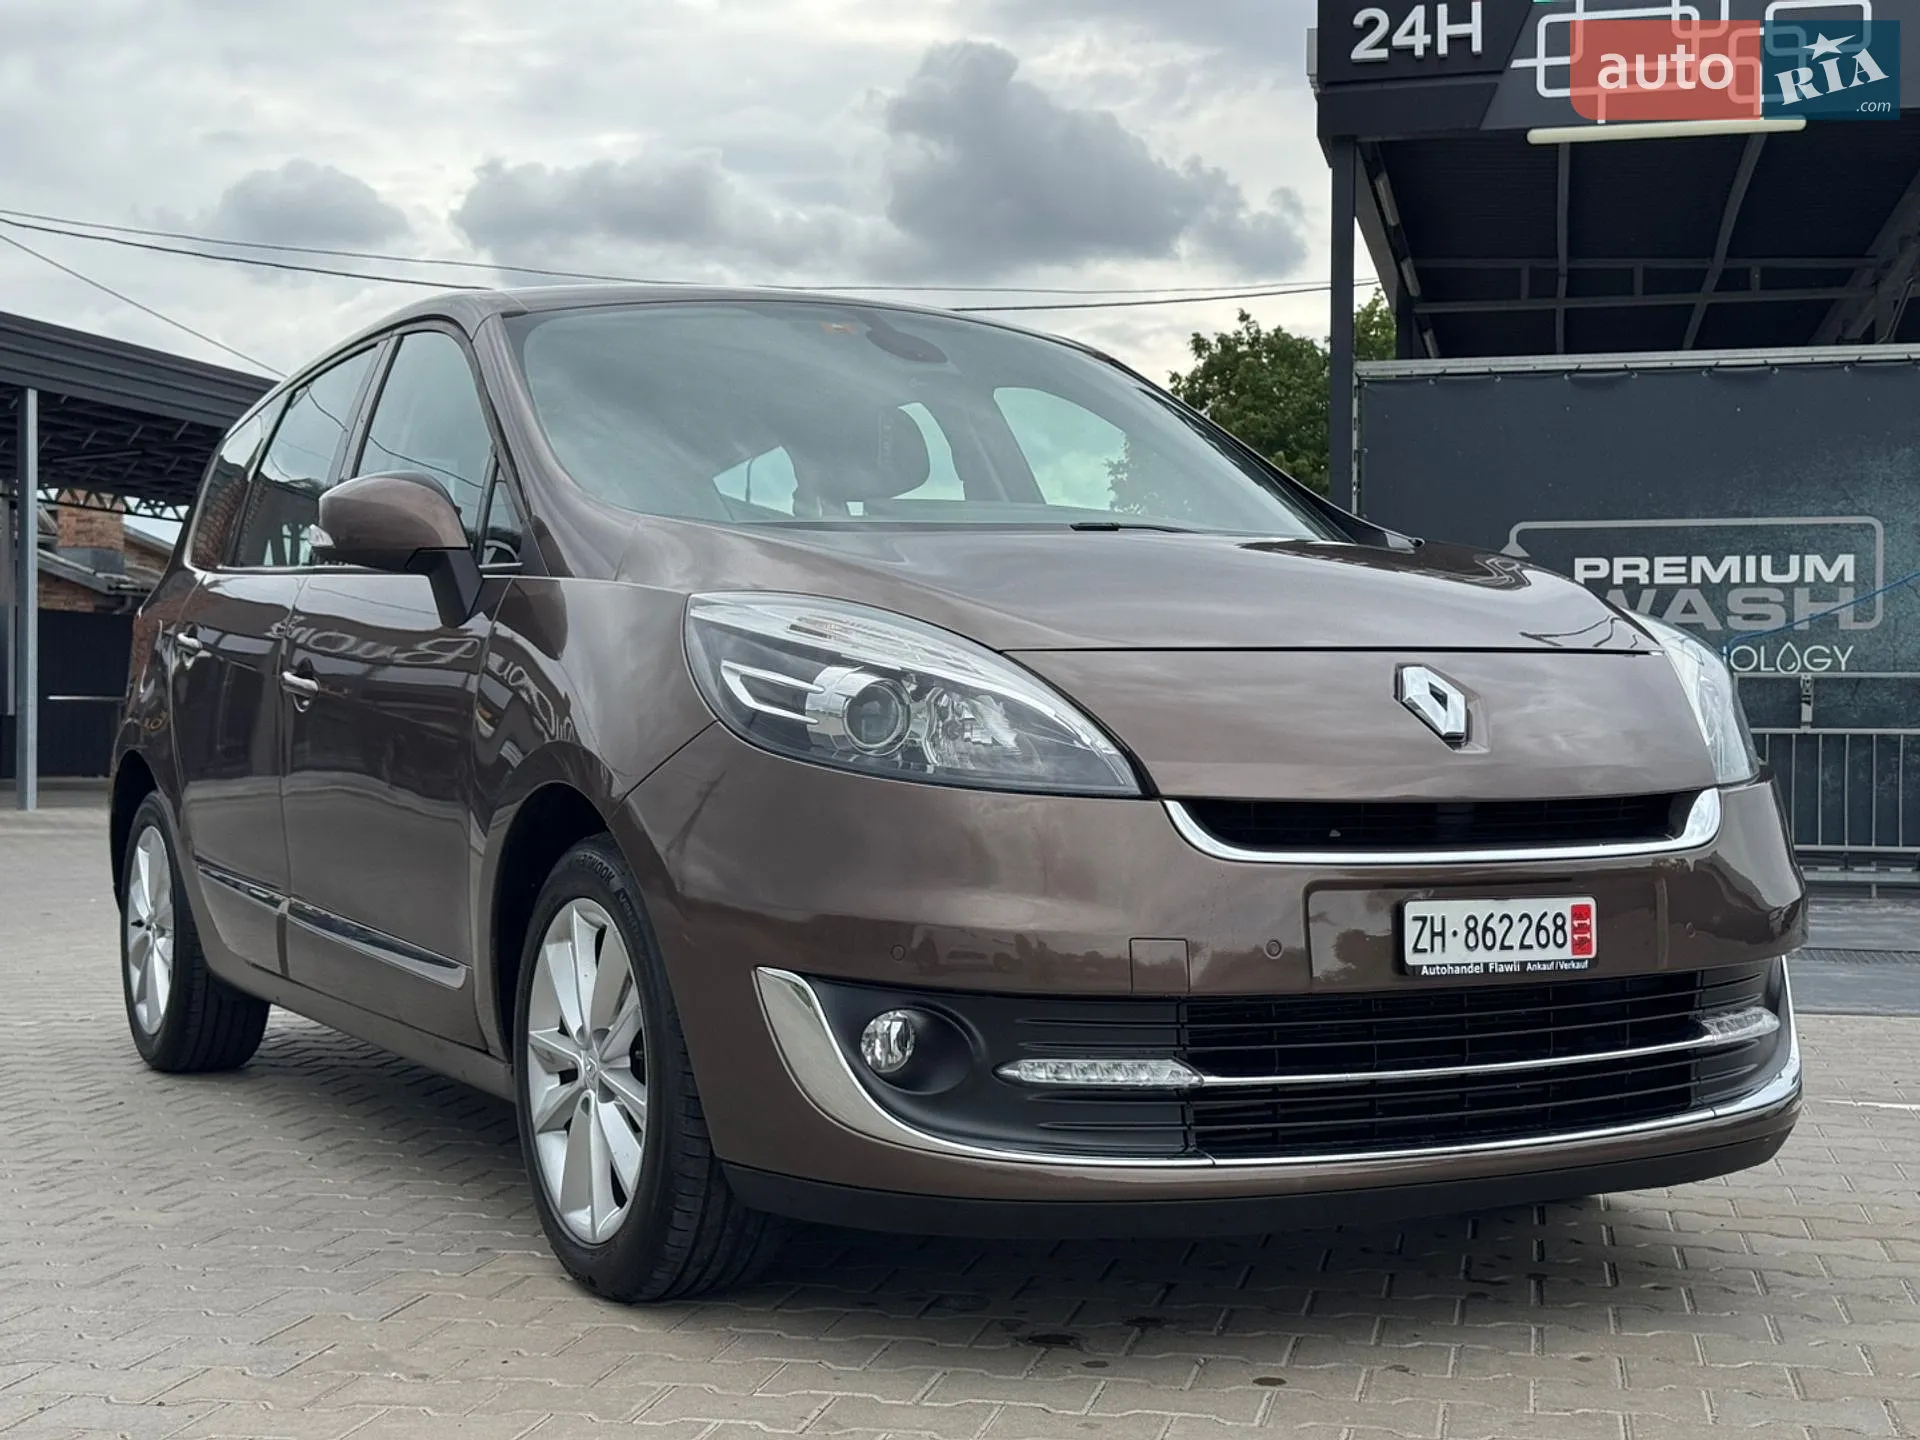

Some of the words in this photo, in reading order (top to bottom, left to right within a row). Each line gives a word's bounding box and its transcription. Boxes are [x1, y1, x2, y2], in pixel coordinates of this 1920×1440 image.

[1350, 1, 1483, 63] 24H
[1573, 554, 1855, 585] PREMIUM
[1421, 961, 1484, 976] Autohandel
